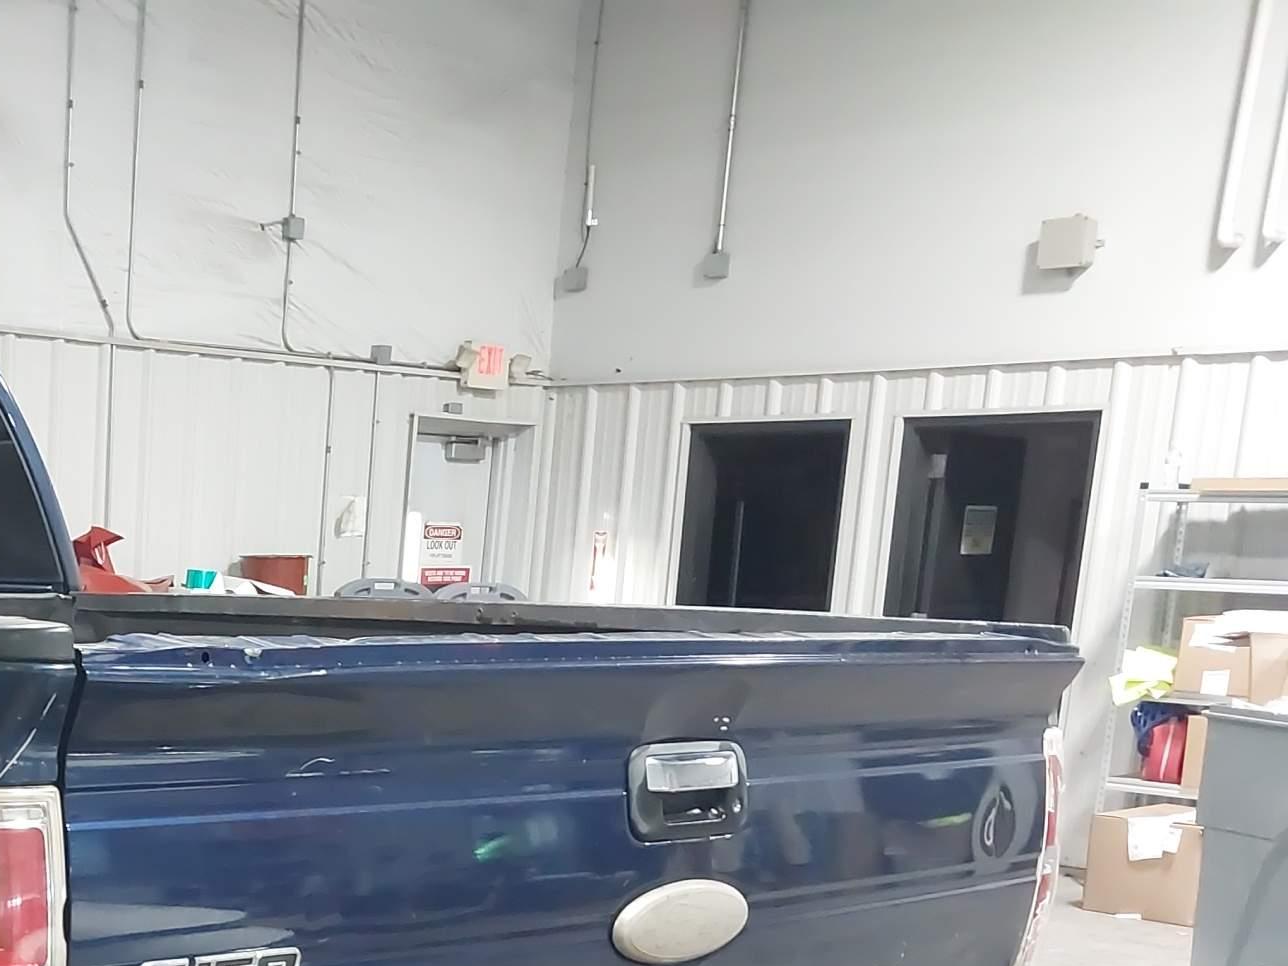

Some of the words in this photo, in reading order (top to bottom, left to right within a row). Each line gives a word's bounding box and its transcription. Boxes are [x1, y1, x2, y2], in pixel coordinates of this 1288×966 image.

[478, 345, 504, 375] EXIT
[428, 527, 457, 537] DANGER
[426, 540, 443, 550] LOOK
[444, 540, 457, 551] OUT
